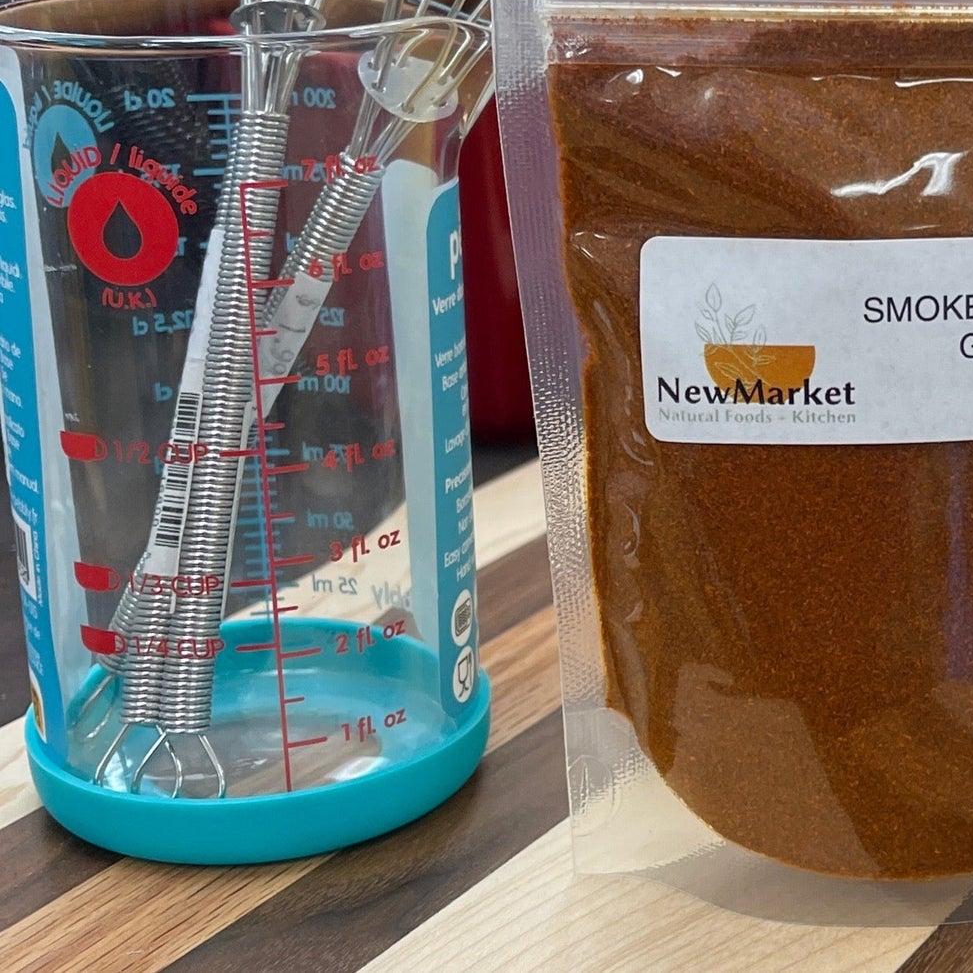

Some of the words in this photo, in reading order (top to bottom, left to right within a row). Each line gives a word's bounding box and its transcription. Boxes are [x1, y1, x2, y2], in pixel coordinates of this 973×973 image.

[128, 145, 198, 215] liquide
[354, 155, 381, 175] oz
[309, 258, 323, 279] 6
[359, 250, 384, 270] oz
[316, 353, 330, 376] 5
[364, 345, 389, 366] oz
[657, 376, 856, 406] NewMarket
[658, 407, 719, 424] Natural
[725, 409, 772, 424] Foods
[792, 409, 856, 424] Kitchen
[158, 443, 209, 465] CUP
[322, 449, 338, 471] 4
[372, 439, 396, 459] oz
[330, 540, 343, 562] 3
[378, 529, 401, 549] oz
[171, 574, 220, 596] CUP
[177, 638, 225, 659] CUP
[335, 633, 348, 654] 2
[383, 620, 405, 639] oz
[341, 723, 350, 741] 1
[384, 708, 406, 728] oz
